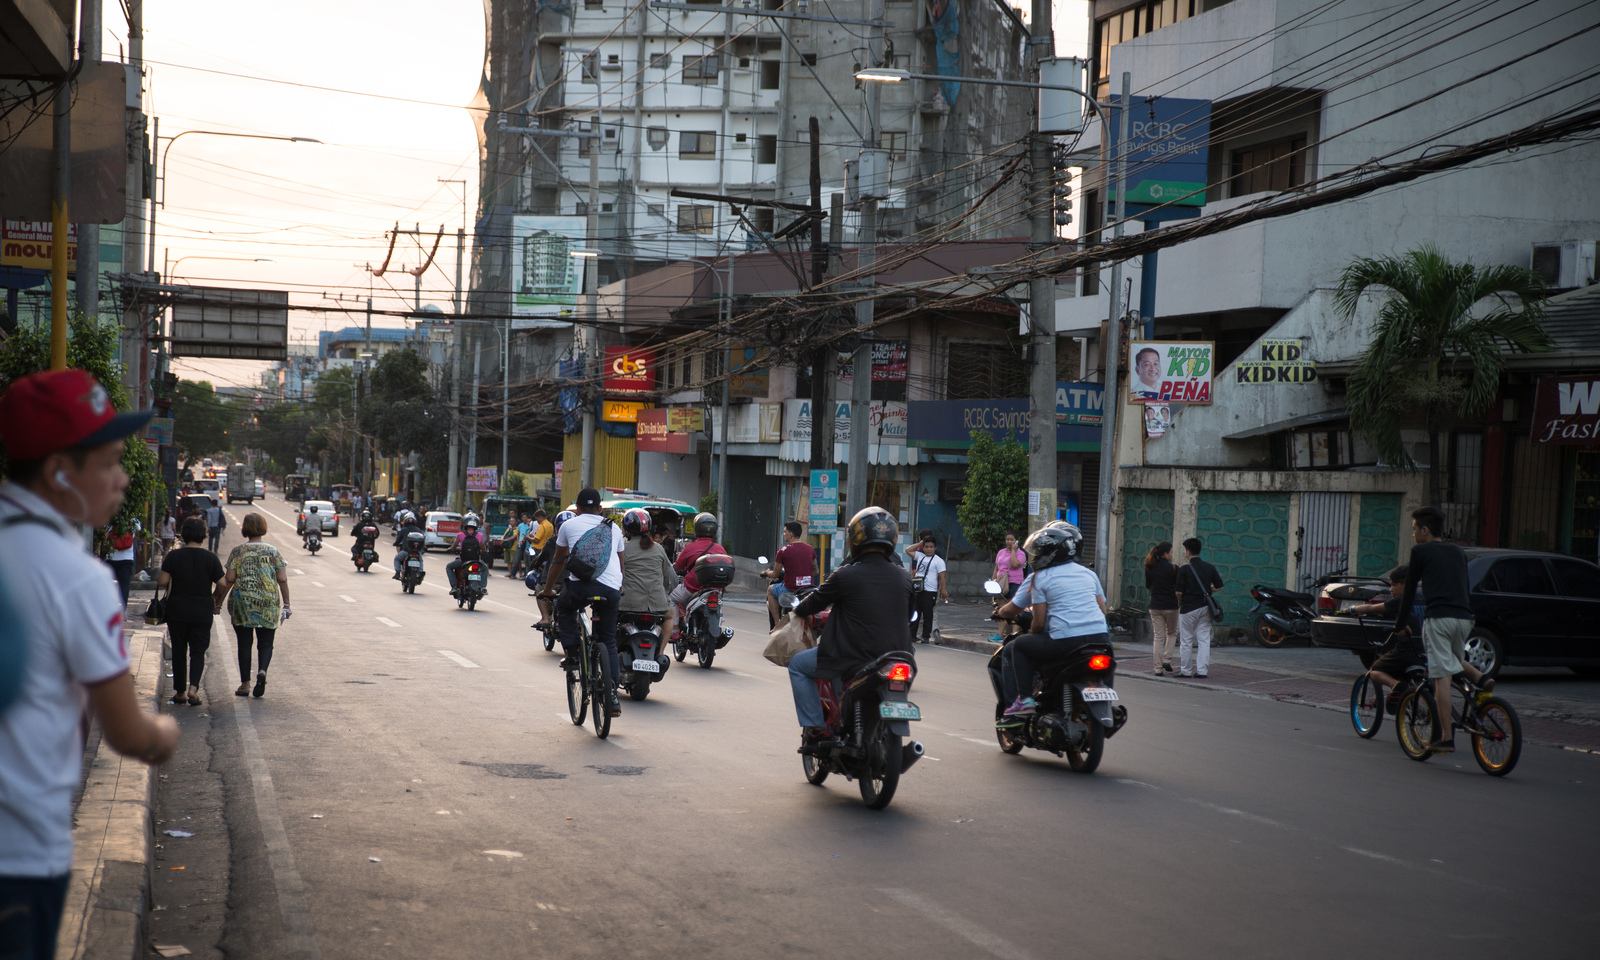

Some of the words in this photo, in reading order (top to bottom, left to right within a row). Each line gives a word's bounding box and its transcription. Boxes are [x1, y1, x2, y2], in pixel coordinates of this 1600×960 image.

[1132, 121, 1187, 140] RCBC
[1119, 140, 1165, 155] avings
[1167, 346, 1211, 358] MAYOR
[1262, 345, 1300, 361] KID
[1238, 366, 1276, 383] KID
[1278, 366, 1317, 383] KID
[1159, 376, 1210, 400] PEÑA
[1055, 387, 1104, 410] ATM
[610, 404, 630, 414] ATM
[964, 407, 990, 429] RCBC
[992, 407, 1031, 433] Savings
